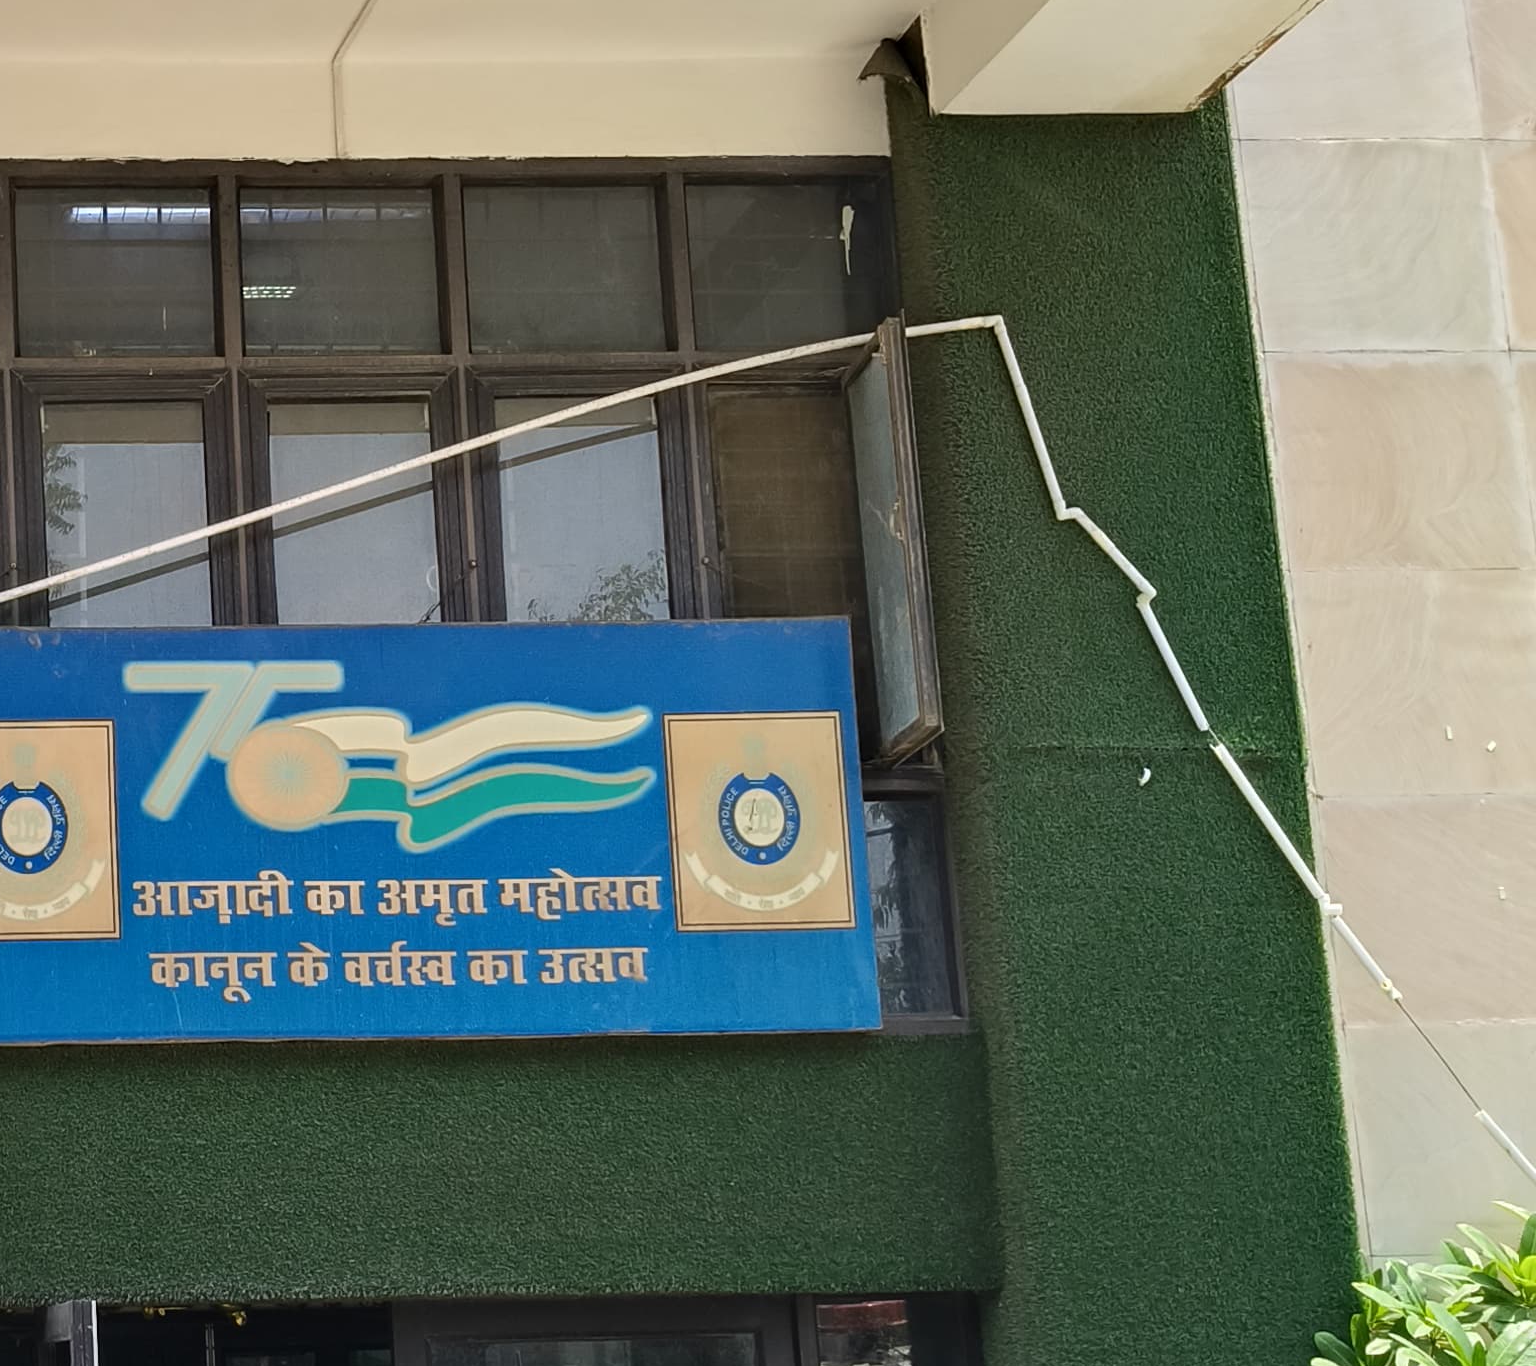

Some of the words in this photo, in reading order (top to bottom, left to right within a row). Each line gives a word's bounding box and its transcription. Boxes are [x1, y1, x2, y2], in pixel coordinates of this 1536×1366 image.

[721, 787, 738, 825] POLICE
[723, 827, 749, 856] DELHI
[304, 876, 364, 916] का
[377, 876, 487, 929] अमृत
[499, 863, 662, 921] महोत्सव
[149, 948, 276, 1003] कानून
[288, 941, 330, 988] के
[343, 941, 459, 988] वर्चस्व
[470, 948, 526, 987] का
[539, 944, 649, 987] उत्सव
